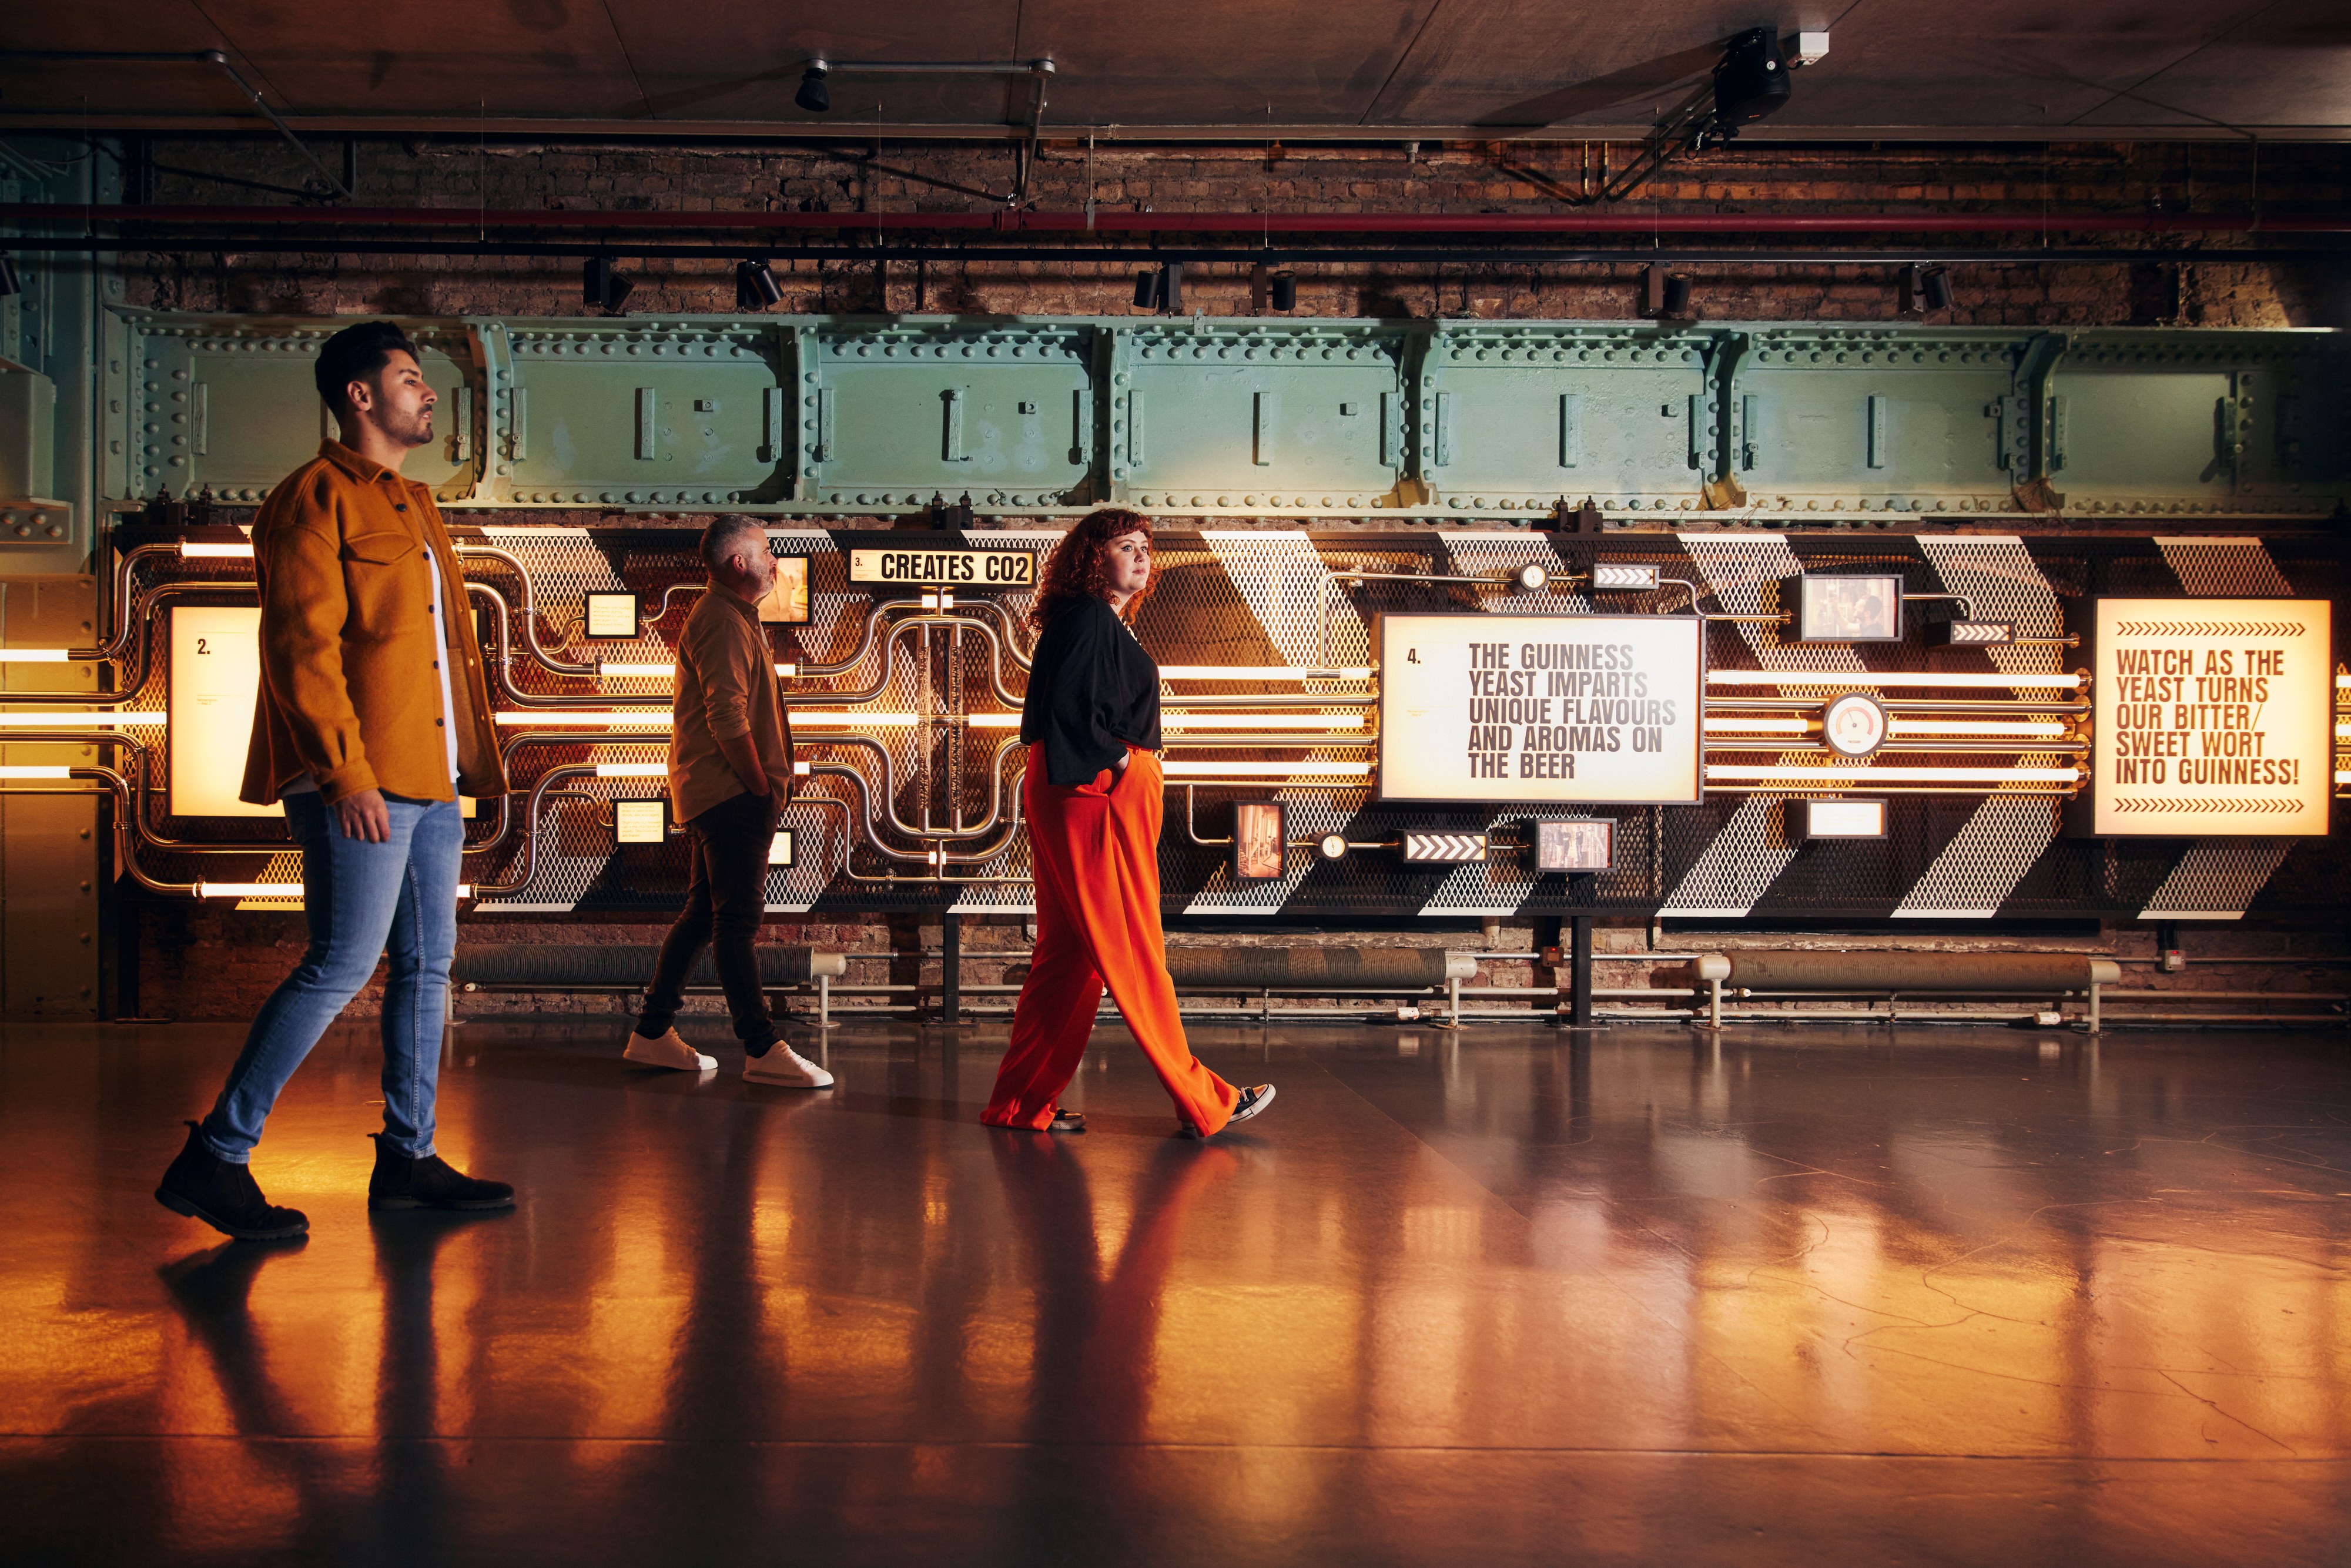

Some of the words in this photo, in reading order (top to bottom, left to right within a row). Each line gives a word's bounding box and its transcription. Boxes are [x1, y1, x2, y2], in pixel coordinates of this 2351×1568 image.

[855, 557, 862, 567] 3.
[882, 554, 974, 580] CREATES
[986, 555, 1028, 581] CO2
[197, 638, 210, 655] 2.
[1407, 648, 1421, 664] 4.
[1469, 643, 1509, 669] THE
[1521, 644, 1633, 670] GUINNESS
[2116, 649, 2192, 675] WATCH
[2205, 650, 2232, 675] AS
[2245, 650, 2284, 675] THE
[1469, 671, 1536, 696] YEAST
[1548, 671, 1647, 698] IMPARTS
[2116, 677, 2185, 702] YEAST
[2196, 677, 2268, 702] TURNS
[1469, 698, 1551, 726] UNIQUE
[1563, 699, 1676, 725] FLAVOURS
[2116, 704, 2162, 729] OUR
[1468, 726, 1512, 751] AND
[1523, 726, 1620, 752] AROMAS
[1633, 727, 1662, 752] ON
[2116, 731, 2191, 757] SWEET
[2202, 732, 2265, 757] WORT
[1468, 753, 1509, 778] THE
[1521, 753, 1575, 779] BEER
[2116, 759, 2166, 784] INTO
[2178, 759, 2299, 785] GUINNESS!
